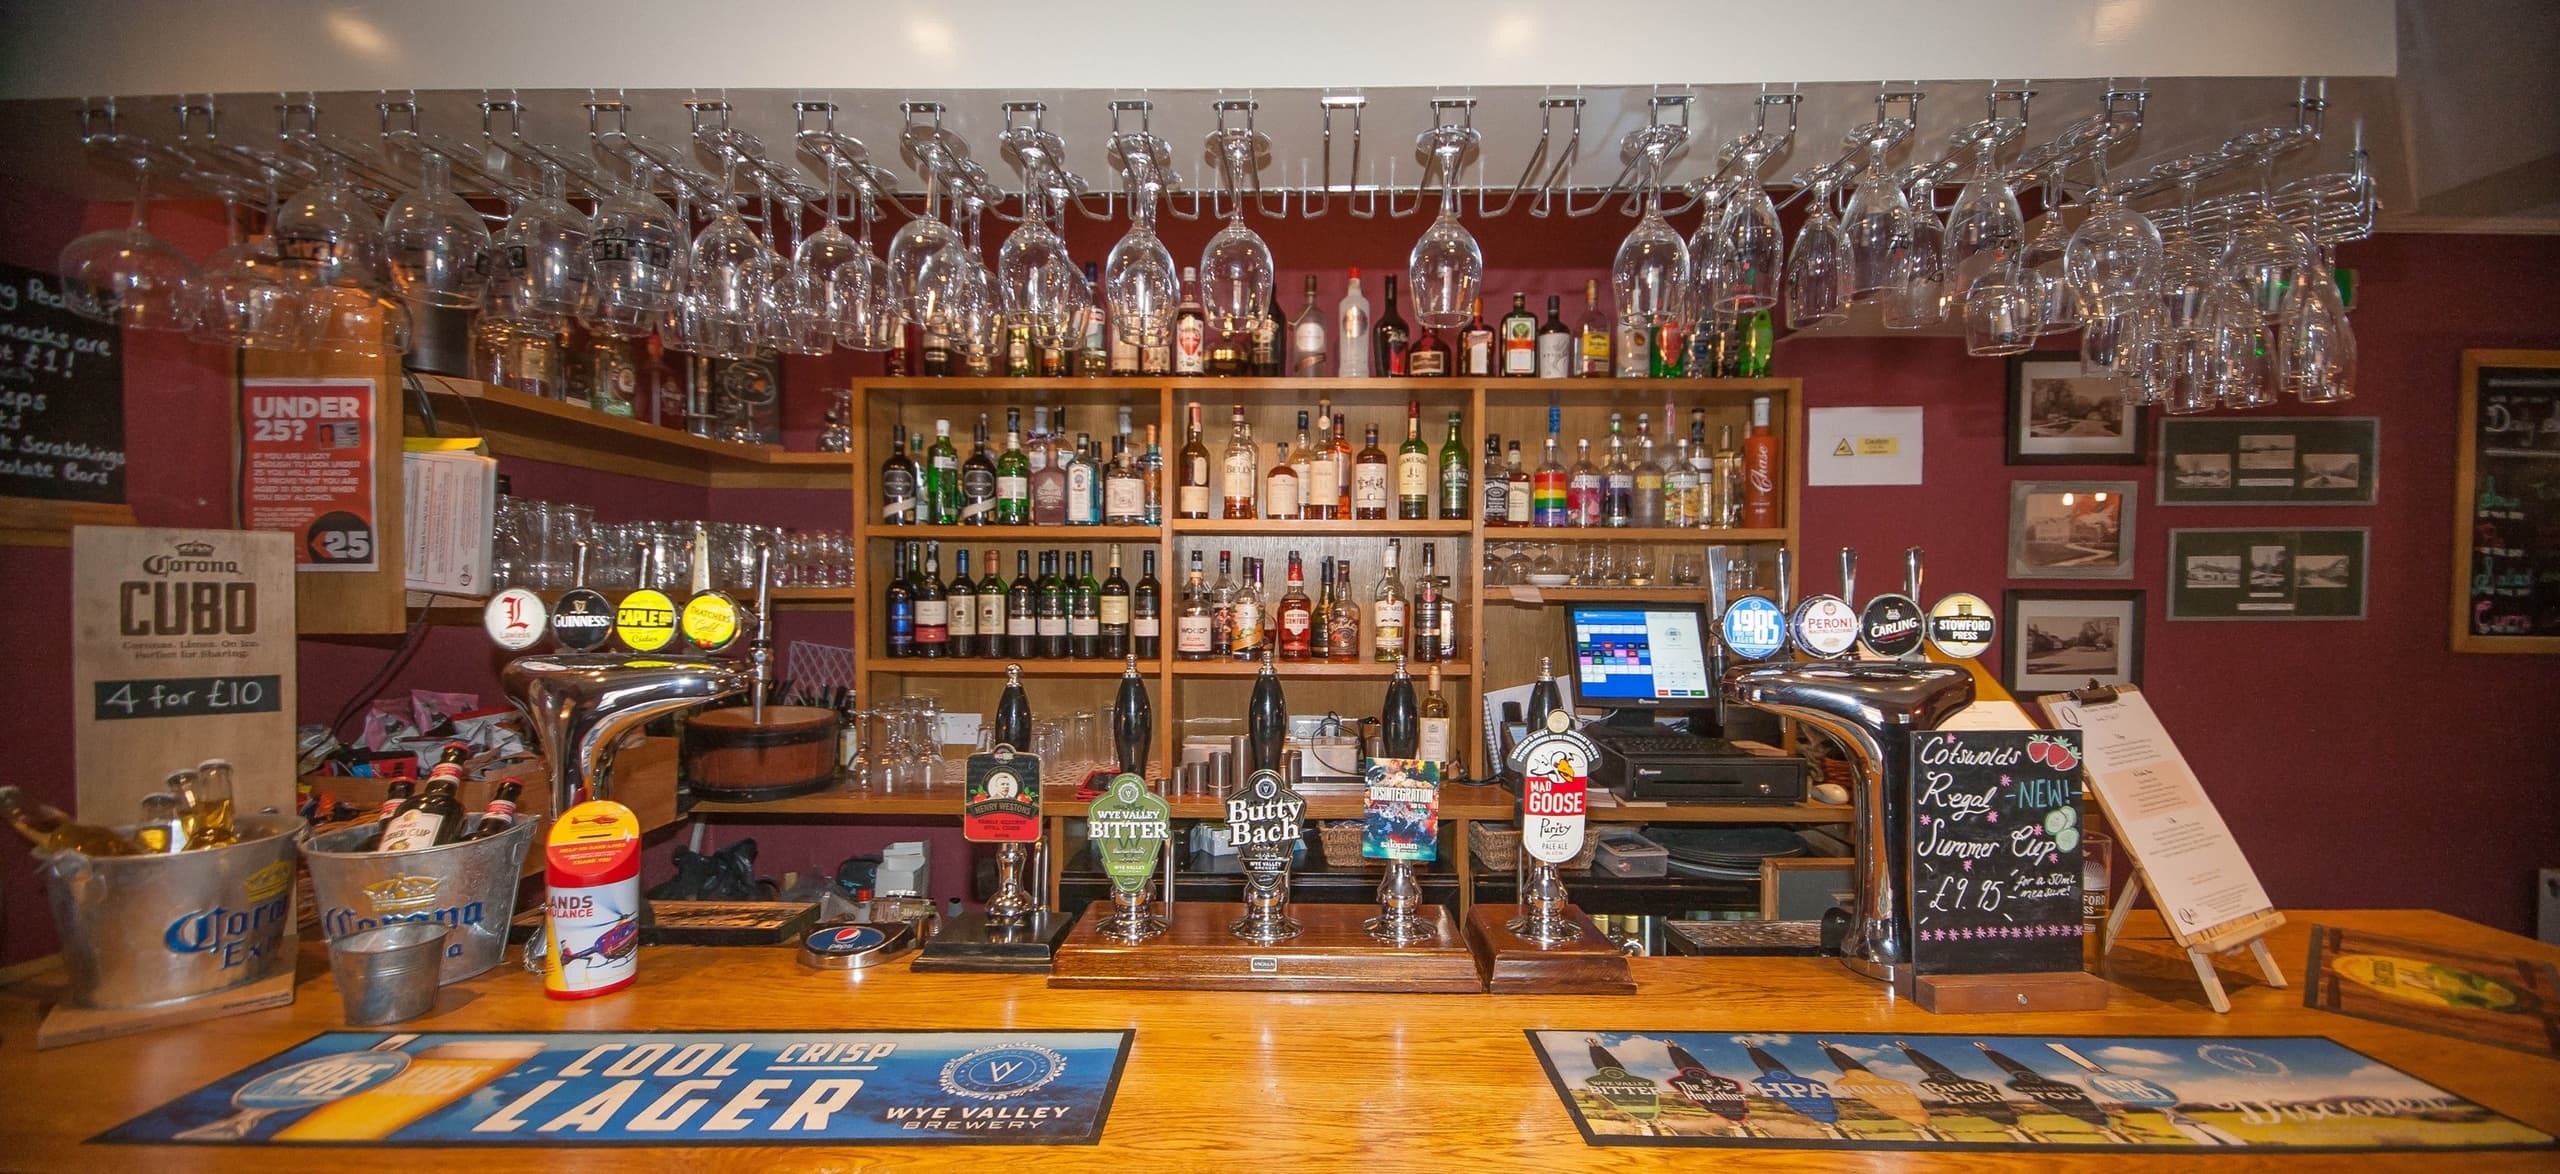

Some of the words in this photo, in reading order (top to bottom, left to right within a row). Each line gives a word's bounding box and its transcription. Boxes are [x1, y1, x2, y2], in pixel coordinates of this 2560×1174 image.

[252, 397, 361, 419] UNDER
[252, 420, 308, 442] 25?
[1749, 443, 1770, 495] Chase
[325, 531, 370, 559] 25
[143, 555, 243, 577] Corona
[120, 581, 257, 636] CUBO
[553, 614, 610, 628] GUINNESS
[618, 610, 659, 627] CAPLE
[1732, 609, 1779, 645] 1985
[1808, 618, 1853, 629] PERONI
[1939, 620, 1991, 631] STOWFORD
[1871, 617, 1918, 638] CARLING
[1952, 631, 1978, 640] PRESS
[221, 640, 237, 648] On
[180, 650, 196, 658] for
[104, 683, 140, 714] 4
[149, 684, 197, 711] for
[207, 680, 263, 708] £10
[1920, 736, 2021, 766] Cotswolds
[1530, 781, 1552, 793] MAD
[1529, 792, 1583, 813] GOOSE
[1918, 771, 1998, 822] Regal
[974, 803, 998, 815] HENRY
[1097, 810, 1121, 819] WYE
[1121, 810, 1160, 819] VALLEY
[1226, 797, 1304, 823] Butty
[1089, 821, 1169, 839] BITTER
[1229, 816, 1301, 846] Bach
[1540, 817, 1572, 839] Purity
[1541, 842, 1556, 850] PALE
[1557, 842, 1568, 850] ALE
[1917, 818, 2000, 858] Summer
[2010, 825, 2056, 866] Cup
[2013, 875, 2035, 891] for
[2036, 876, 2046, 886] a
[2020, 885, 2072, 898] measure!
[1929, 876, 2004, 912] £9.95
[2082, 896, 2106, 906] FORD
[2082, 905, 2095, 914] SS
[557, 1042, 755, 1078] COOL
[775, 1042, 900, 1064] CRISP
[1585, 1085, 1665, 1096] BITTER
[1675, 1080, 1702, 1092] The
[1751, 1081, 1832, 1100] HPA
[1921, 1081, 1993, 1094] Butty
[1682, 1088, 1748, 1103] Hopfather
[1939, 1092, 2004, 1104] Bach
[471, 1078, 865, 1132] LAGER
[886, 1106, 951, 1120] WYE
[960, 1106, 1070, 1120] VALLEY
[901, 1120, 1045, 1130] BREWERY
